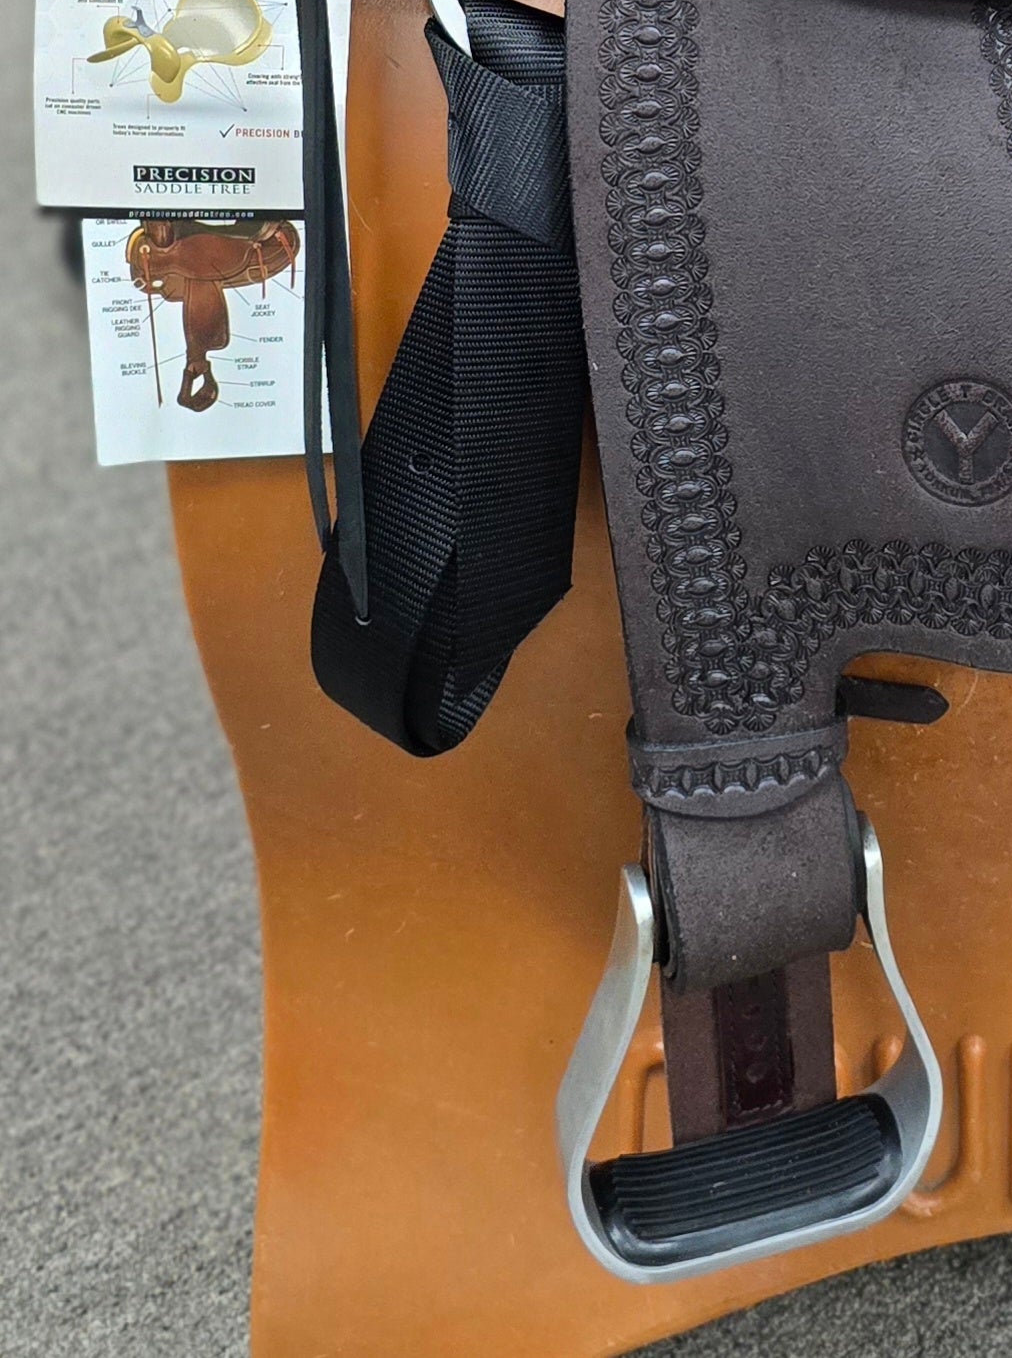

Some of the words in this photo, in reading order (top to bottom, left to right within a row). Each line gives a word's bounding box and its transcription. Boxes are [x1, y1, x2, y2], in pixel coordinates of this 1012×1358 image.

[236, 128, 290, 138] PRECISION
[136, 167, 252, 182] PRECISION
[134, 183, 202, 194] SADDLE
[207, 184, 250, 195] TREE
